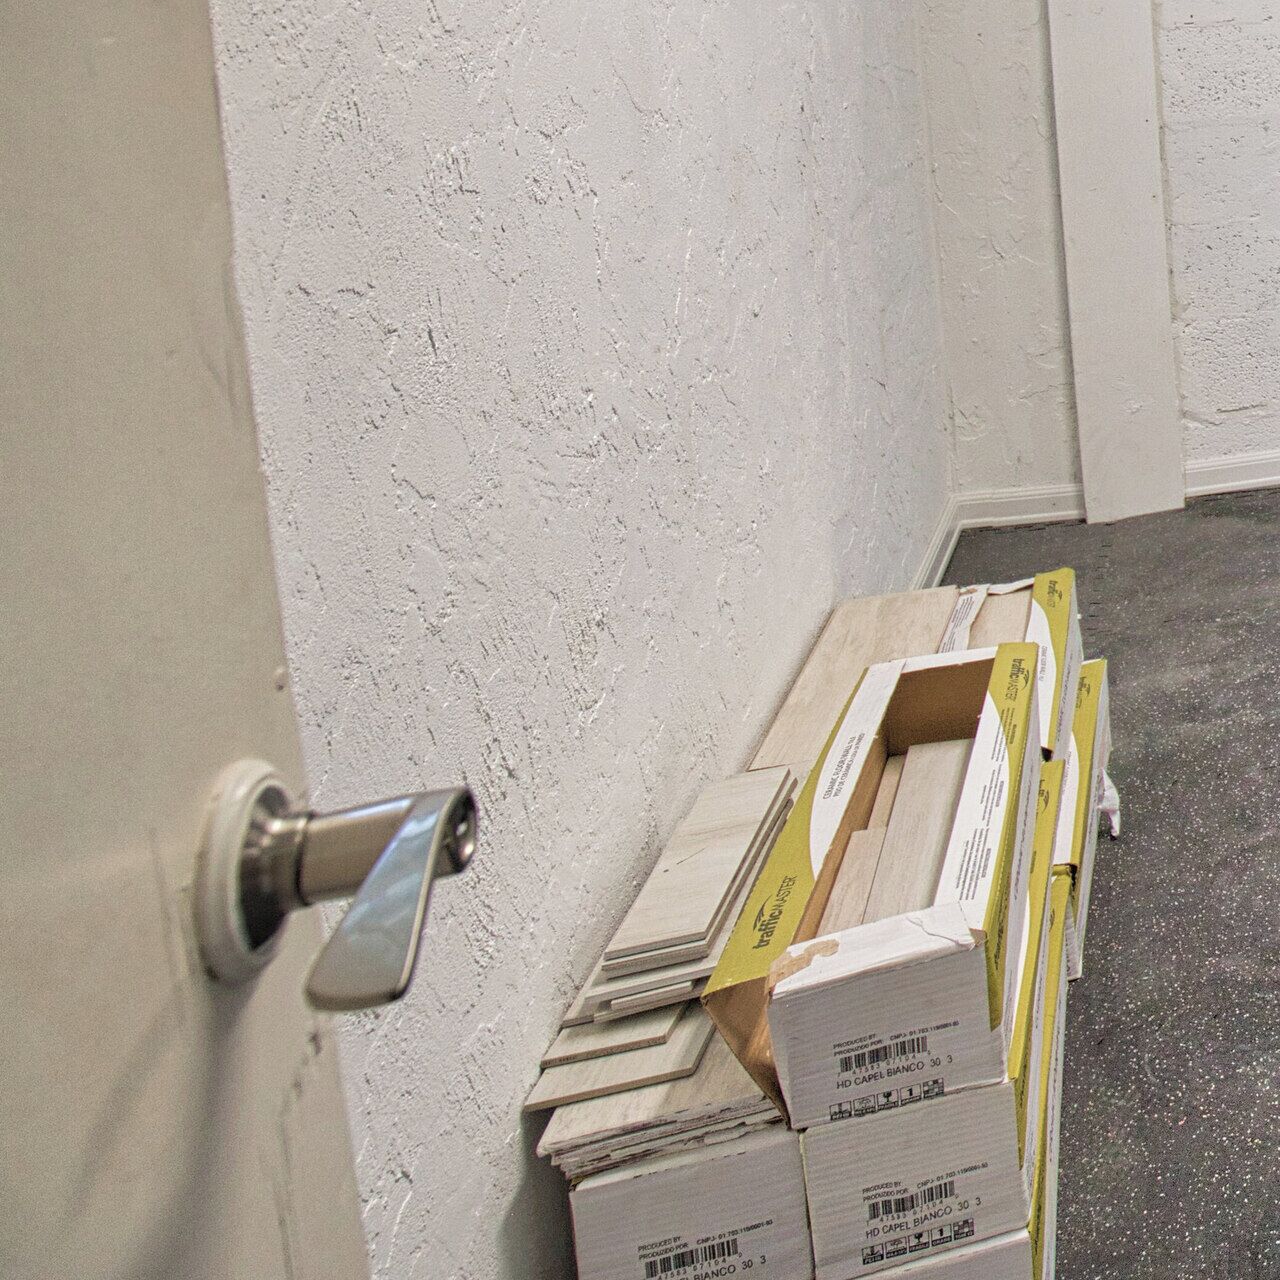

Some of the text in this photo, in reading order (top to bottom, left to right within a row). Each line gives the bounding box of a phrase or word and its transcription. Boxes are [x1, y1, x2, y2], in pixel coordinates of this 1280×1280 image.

[754, 876, 798, 949] trafficMASTER
[833, 1036, 867, 1049] PRODUCED
[836, 1054, 953, 1090] HD CAPEL BIANCO 30 3
[862, 1182, 893, 1194] PRODUCED
[866, 1197, 982, 1239] HD CAPEL BIANCO 30 3
[638, 1239, 671, 1252] PRODUCED
[639, 1246, 675, 1260] PRODUZIDO
[693, 1254, 767, 1280] BIANCO 30 3
